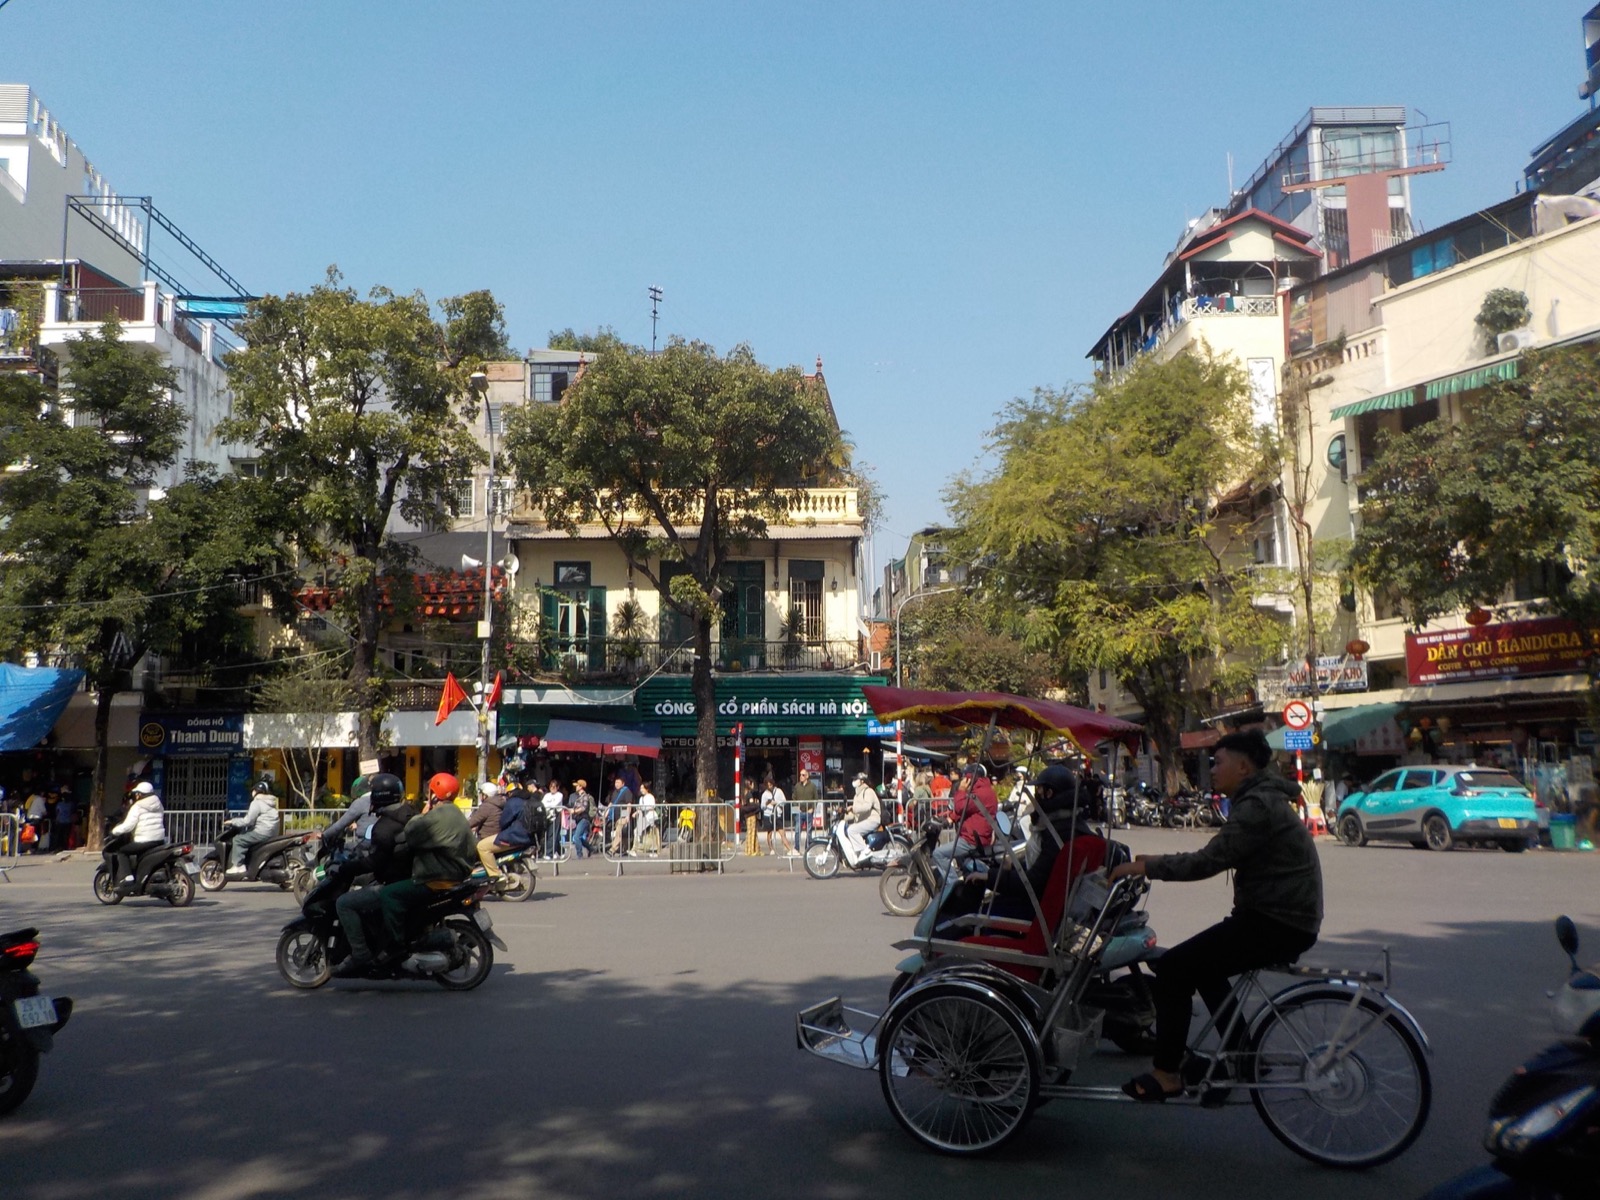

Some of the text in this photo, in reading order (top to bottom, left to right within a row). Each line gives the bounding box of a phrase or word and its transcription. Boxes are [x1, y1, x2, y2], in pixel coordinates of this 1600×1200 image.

[1427, 626, 1600, 662] DÂN CHỦ HANDICRAT
[1438, 661, 1462, 671] COFFEE
[1469, 659, 1482, 668] TEA
[655, 696, 868, 718] CÔNG CỔ PHẦN SÁCH HÀ NỘI
[170, 730, 207, 744] Thanh
[209, 730, 240, 745] Dung
[746, 738, 790, 747] POSTER
